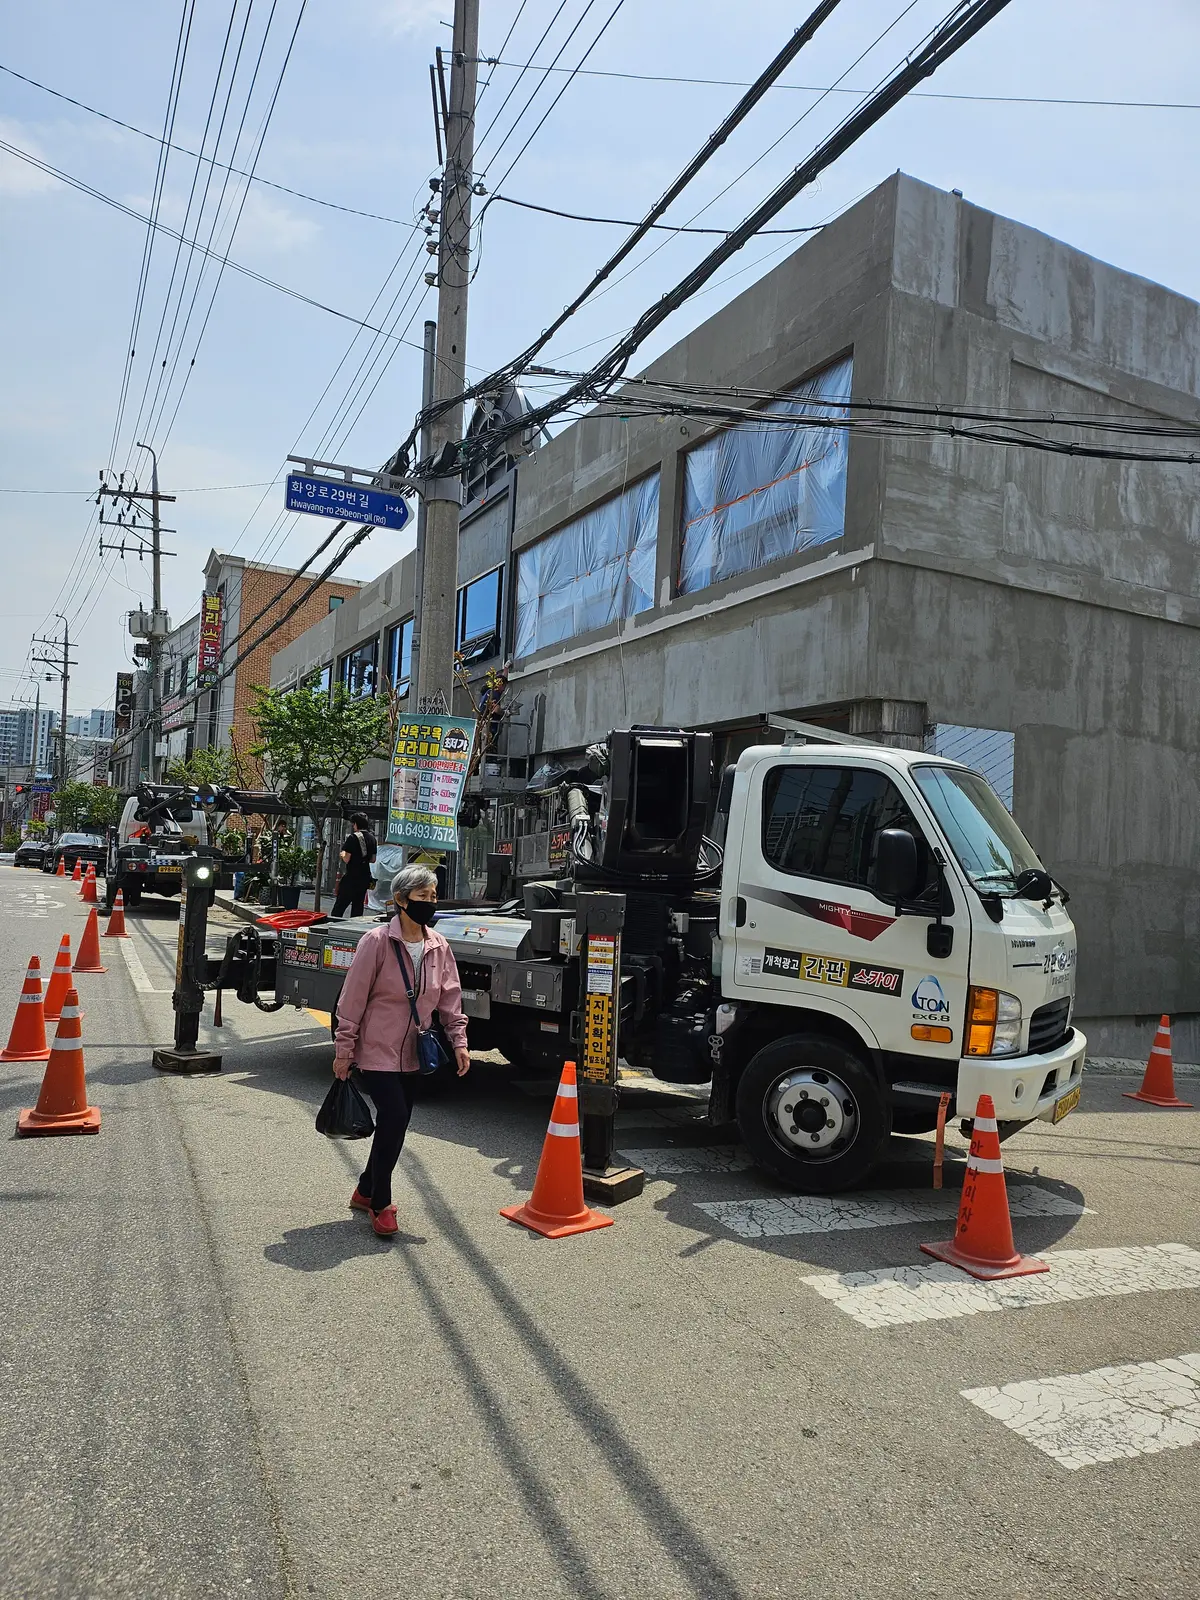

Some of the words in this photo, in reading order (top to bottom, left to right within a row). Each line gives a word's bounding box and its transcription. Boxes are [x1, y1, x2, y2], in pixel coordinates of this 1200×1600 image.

[292, 480, 369, 508] 화양로29번길
[290, 498, 334, 514] Hwayang-ro
[334, 506, 373, 522] 29beon-gil
[373, 514, 386, 524] (Rd)
[116, 688, 131, 717] PC
[396, 740, 440, 757] 빌라매매
[390, 822, 455, 842] 010.6493.7572
[819, 903, 850, 915] MIGHTY
[765, 955, 799, 970] 개척광고
[804, 956, 846, 984] 간판
[852, 968, 899, 990] 스카이
[918, 996, 949, 1013] TON
[592, 1000, 605, 1053] 지반확인
